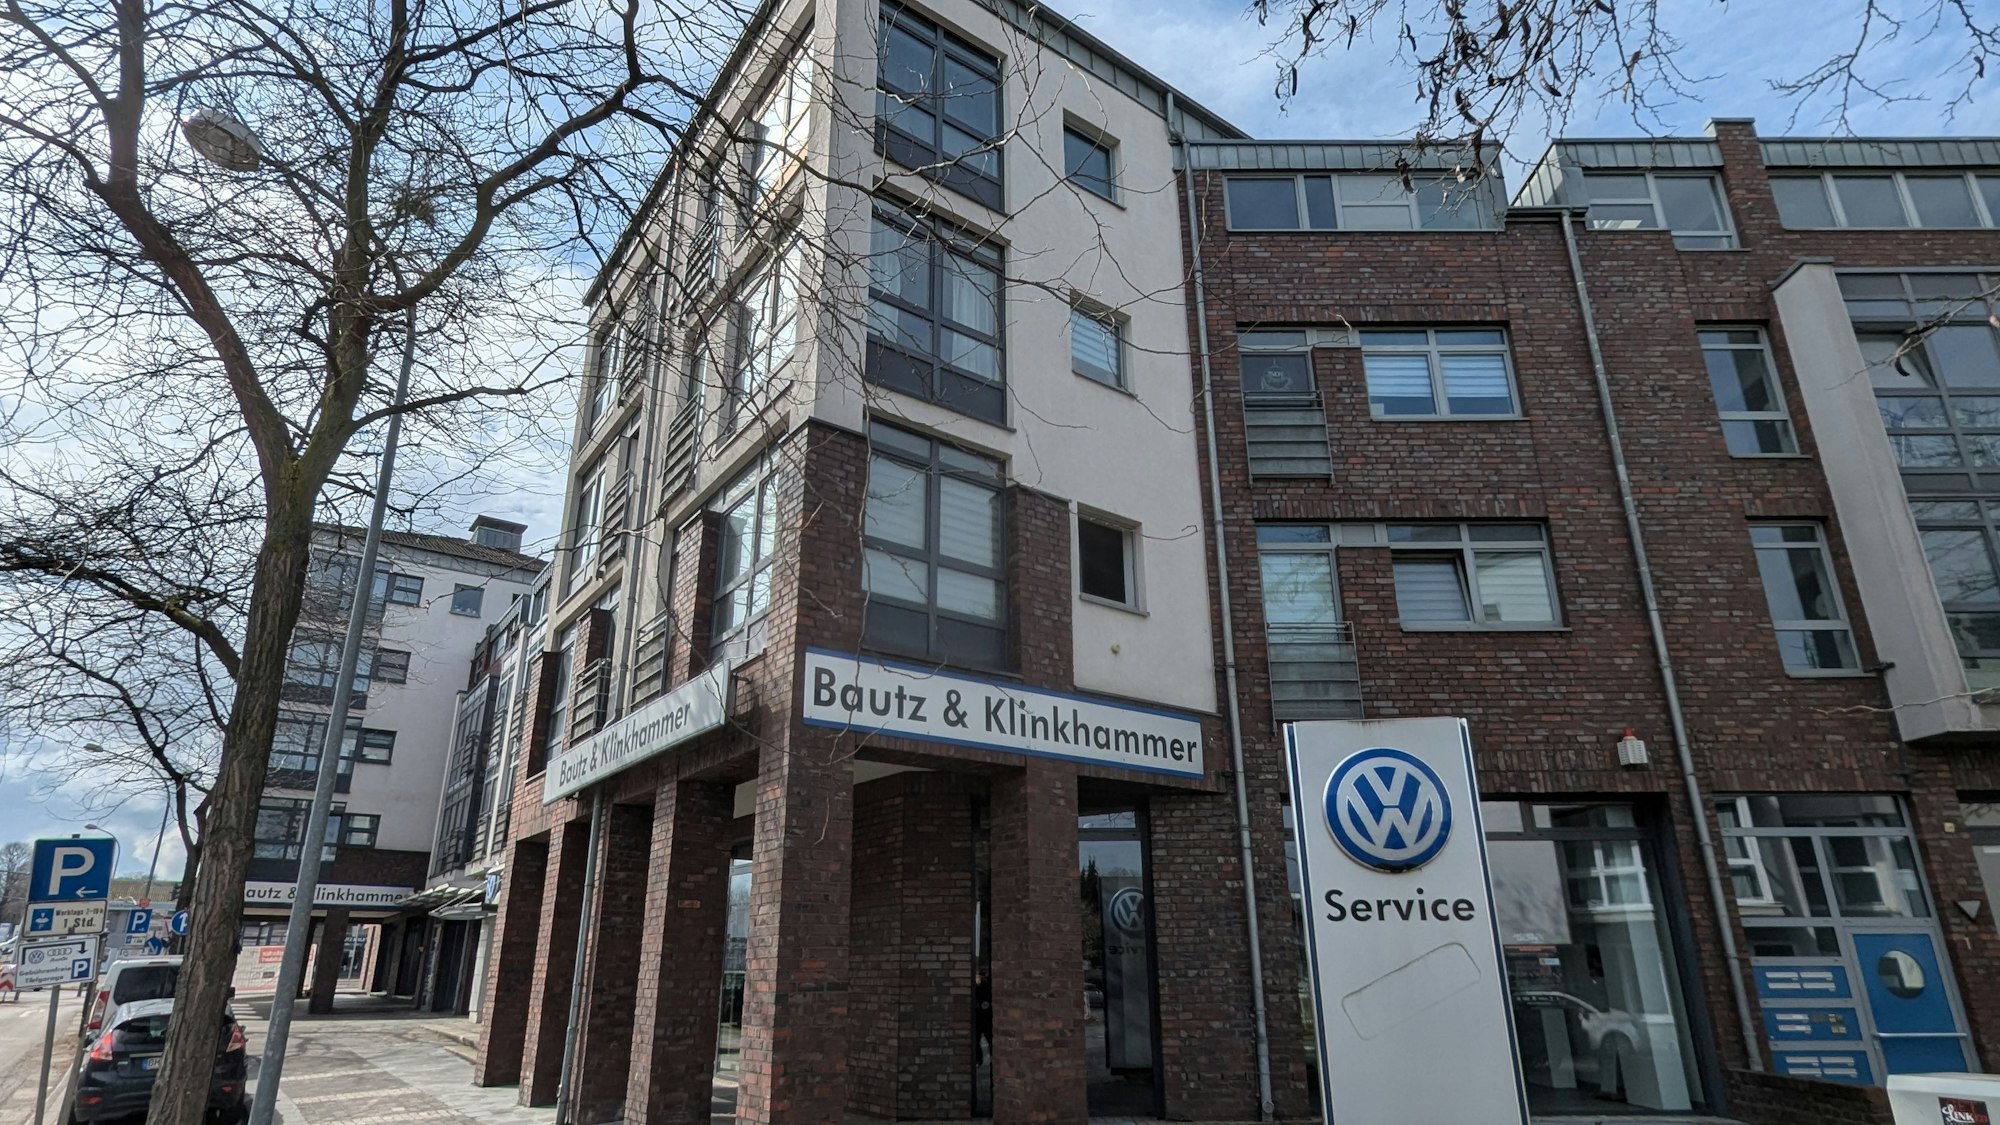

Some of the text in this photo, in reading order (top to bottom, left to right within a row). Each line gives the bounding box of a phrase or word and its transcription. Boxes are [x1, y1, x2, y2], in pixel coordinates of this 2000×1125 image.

[813, 666, 1198, 763] Bautz & Klinkhammer
[559, 702, 691, 787] Bautz & Klinkhammer
[1332, 753, 1447, 865] VW
[48, 847, 95, 895] P
[246, 887, 281, 899] autz
[314, 887, 405, 903] linkhamme
[1325, 887, 1476, 922] Service
[63, 916, 96, 929] 1 Std.
[131, 911, 147, 931] P
[73, 961, 88, 978] P
